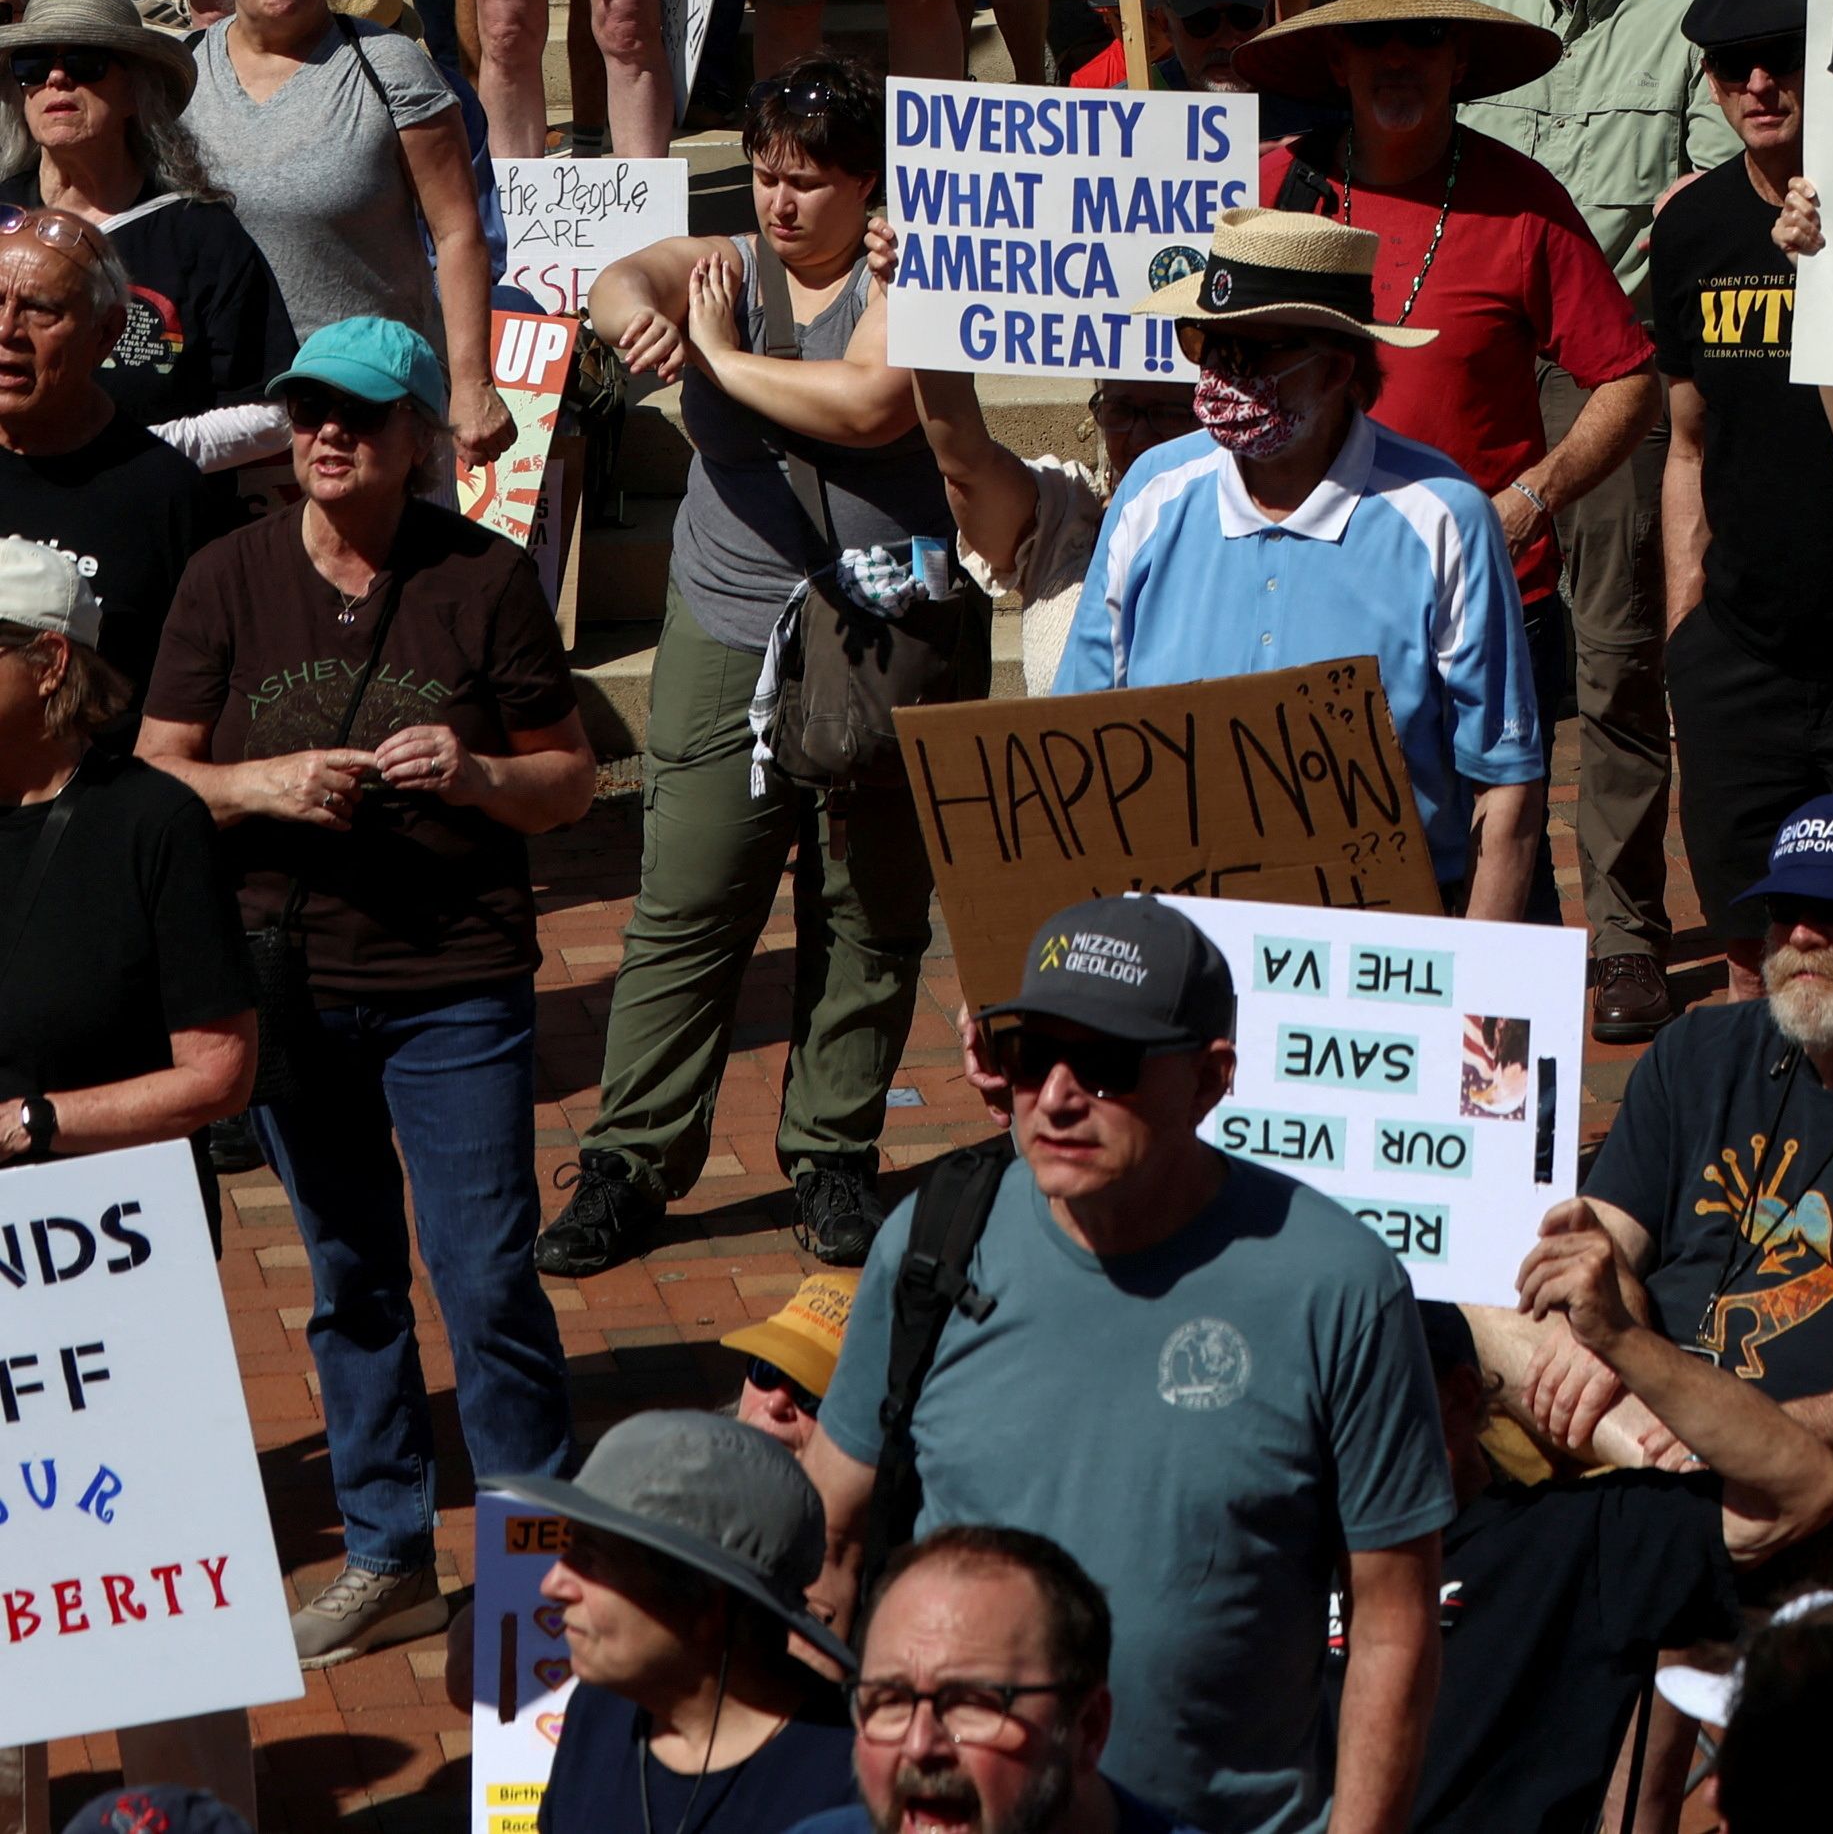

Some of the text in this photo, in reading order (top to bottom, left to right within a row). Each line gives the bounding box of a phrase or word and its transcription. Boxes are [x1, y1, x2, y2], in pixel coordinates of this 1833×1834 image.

[896, 92, 1230, 163] DIVERSITY IS
[897, 168, 1042, 230] WHAT
[897, 233, 1119, 298] AMERICA
[959, 303, 1174, 374] GREAT!!
[1262, 944, 1443, 996] THE VA
[1283, 1032, 1414, 1082] SAVE
[1222, 1116, 1466, 1170] OUR VETS
